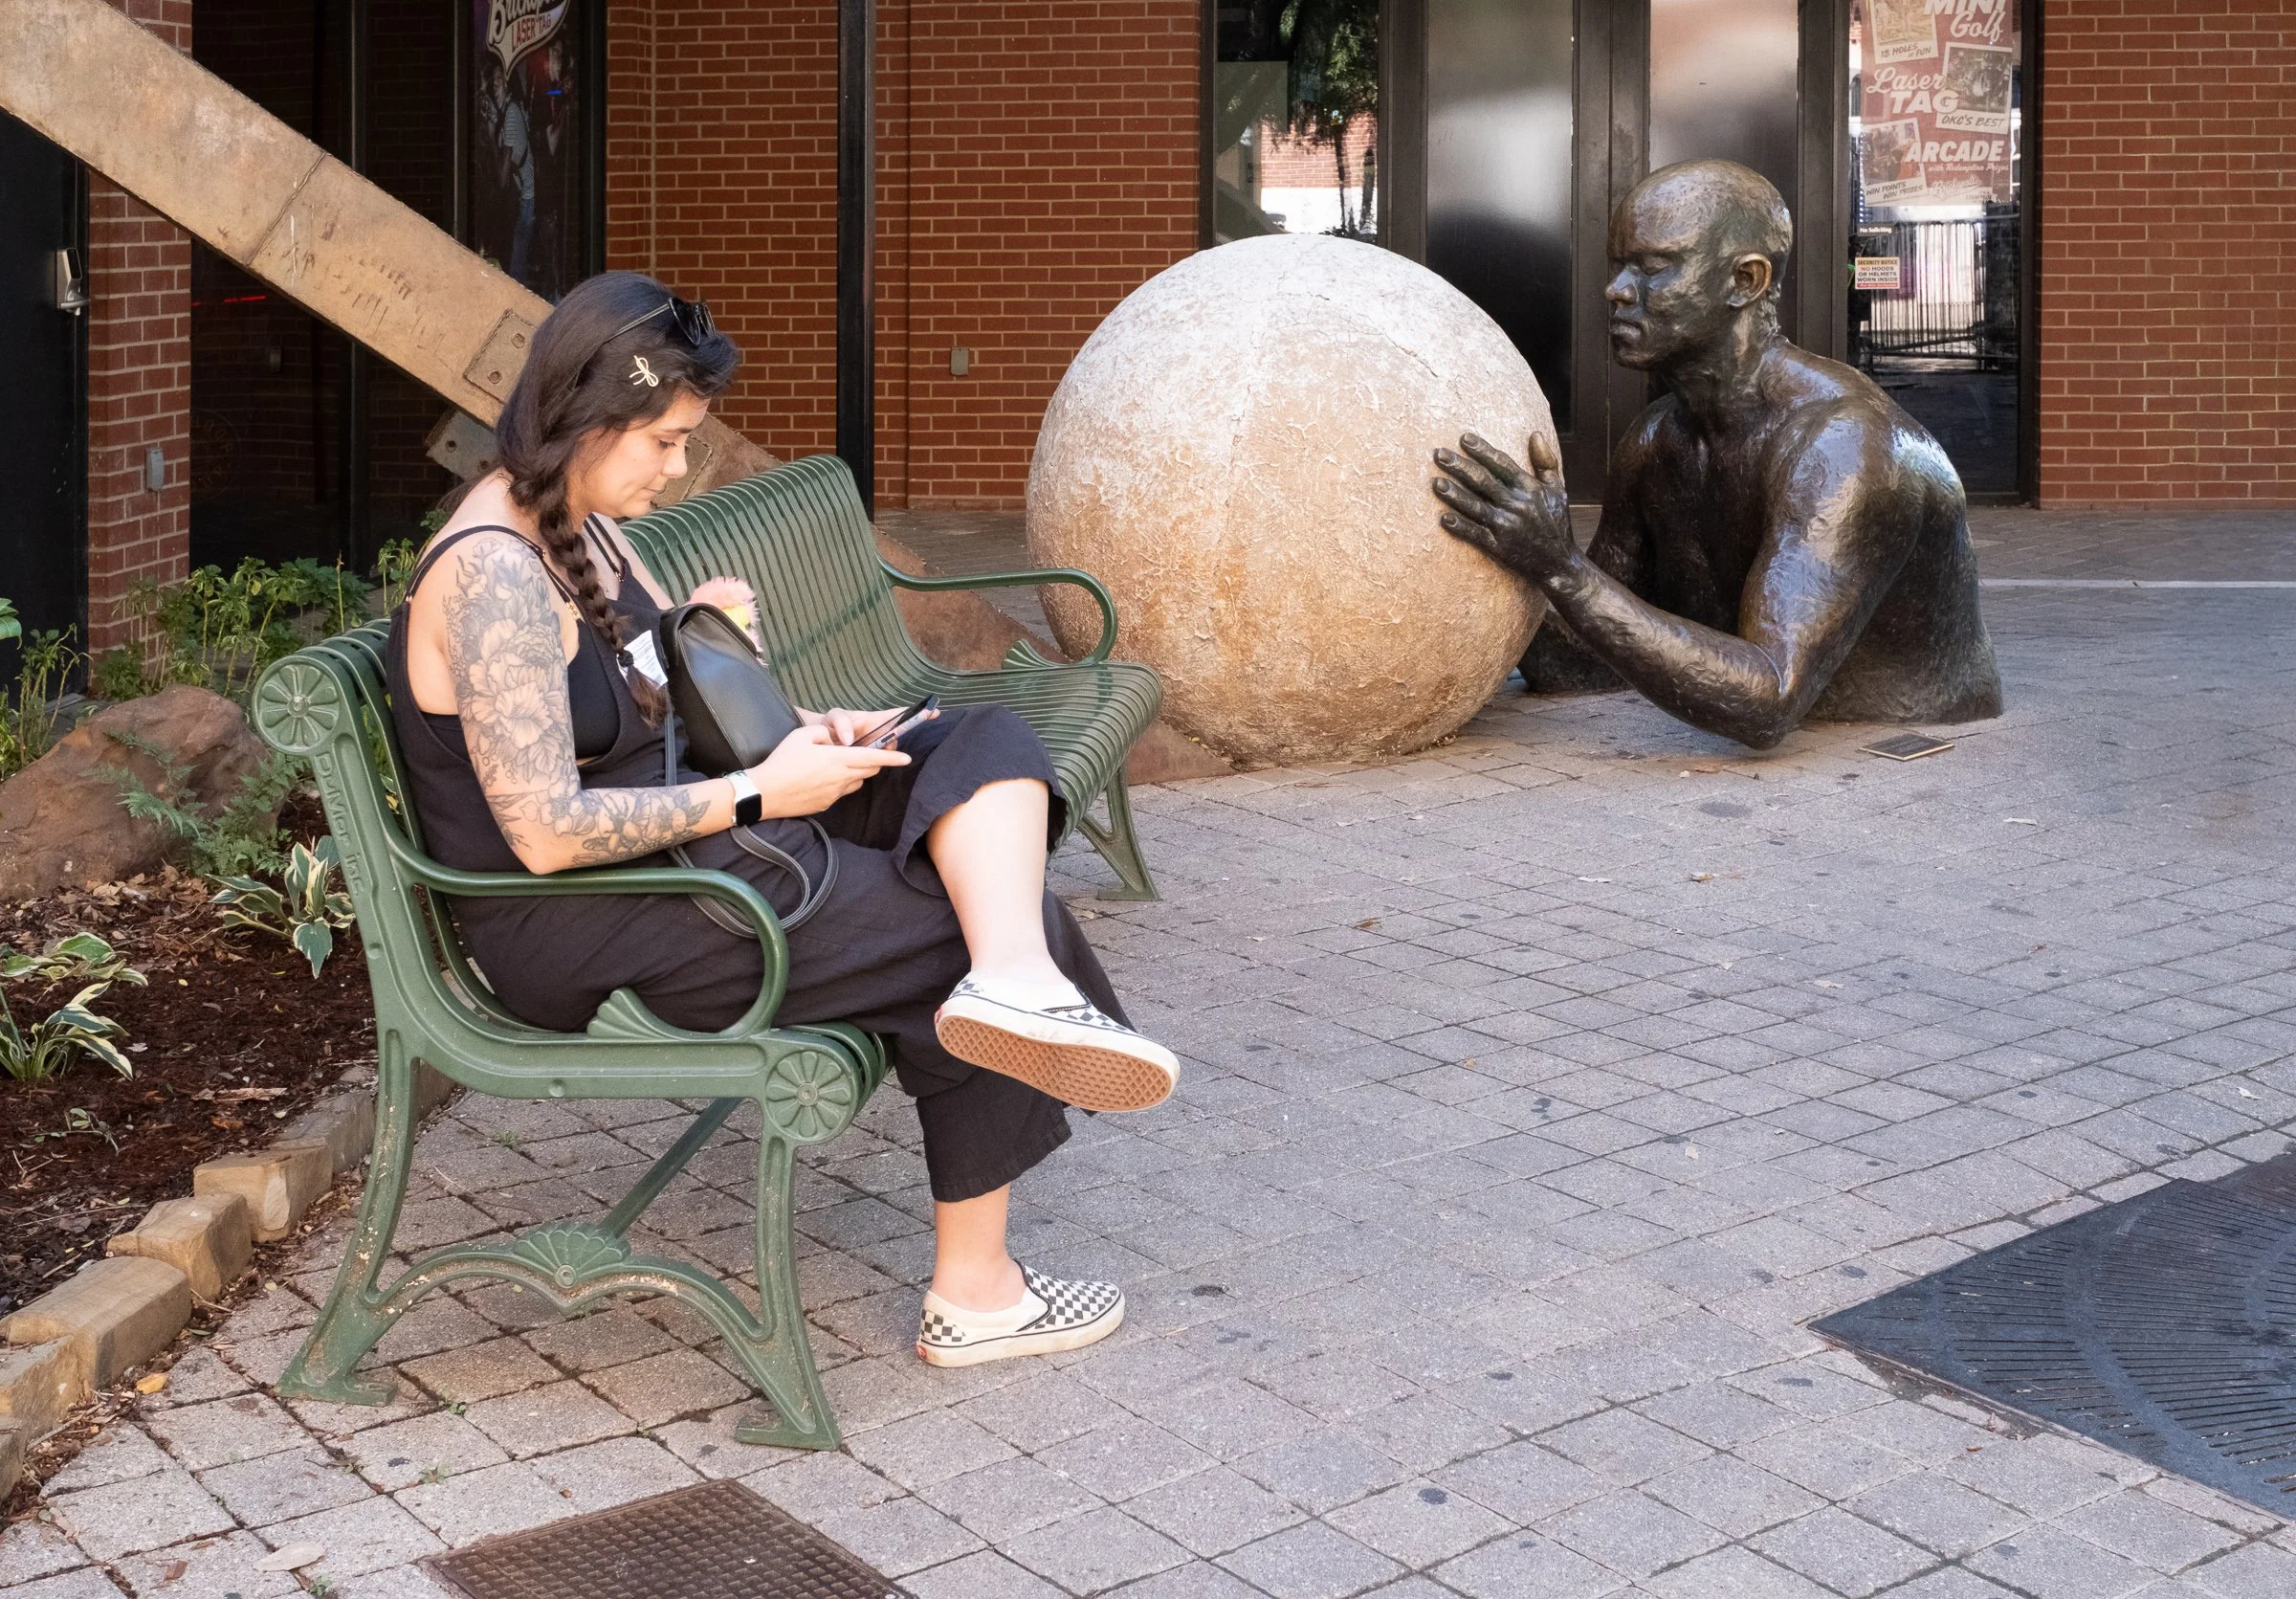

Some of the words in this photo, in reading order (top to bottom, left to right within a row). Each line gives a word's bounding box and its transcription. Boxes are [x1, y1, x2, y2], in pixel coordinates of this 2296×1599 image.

[512, 17, 536, 53] LASER
[538, 13, 552, 34] TAG
[1950, 10, 2005, 42] Golf
[1892, 43, 1918, 56] HOLES
[1916, 46, 1932, 56] FUN
[1866, 67, 1947, 94] Laser
[1890, 89, 1959, 114] TAG
[1942, 115, 1973, 126] OKC'S
[1976, 117, 2005, 127] BEST
[1905, 141, 2005, 163] ARCADE
[1882, 182, 1906, 193] POINTS
[1899, 185, 1923, 195] PRIZES
